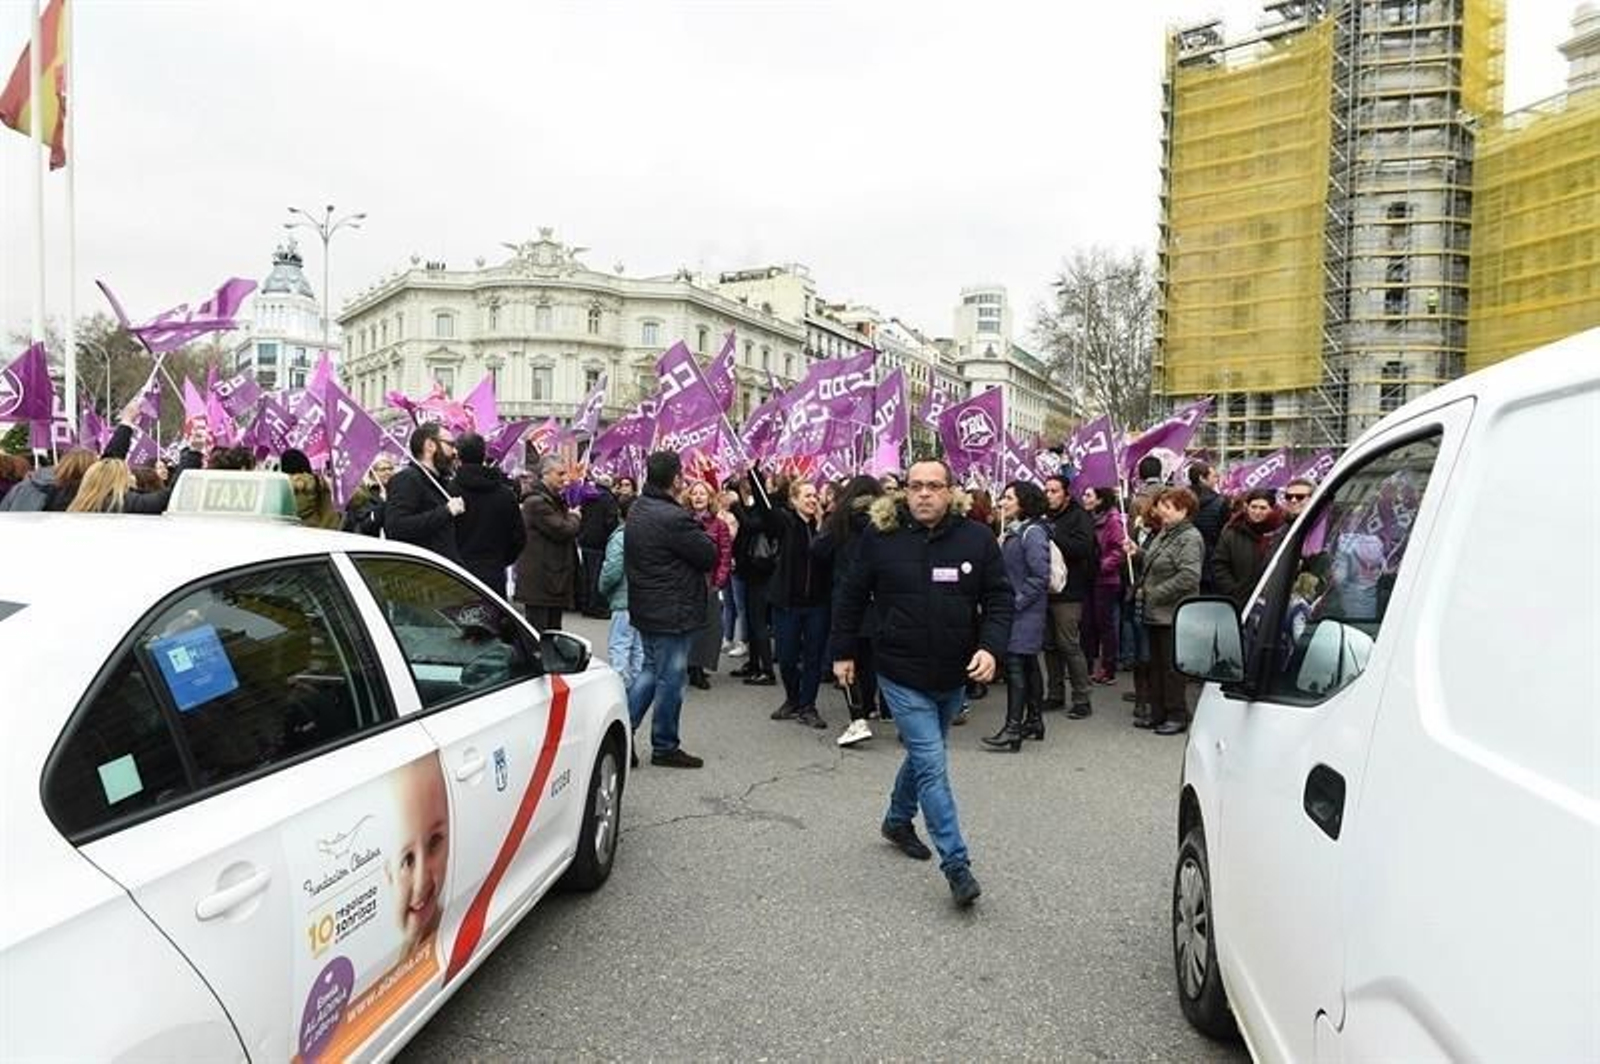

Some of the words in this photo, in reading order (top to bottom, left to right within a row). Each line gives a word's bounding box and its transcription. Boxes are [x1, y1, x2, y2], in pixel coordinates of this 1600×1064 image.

[206, 483, 257, 509] TAXI
[308, 913, 334, 951] 10
[335, 899, 377, 937] sonrisas
